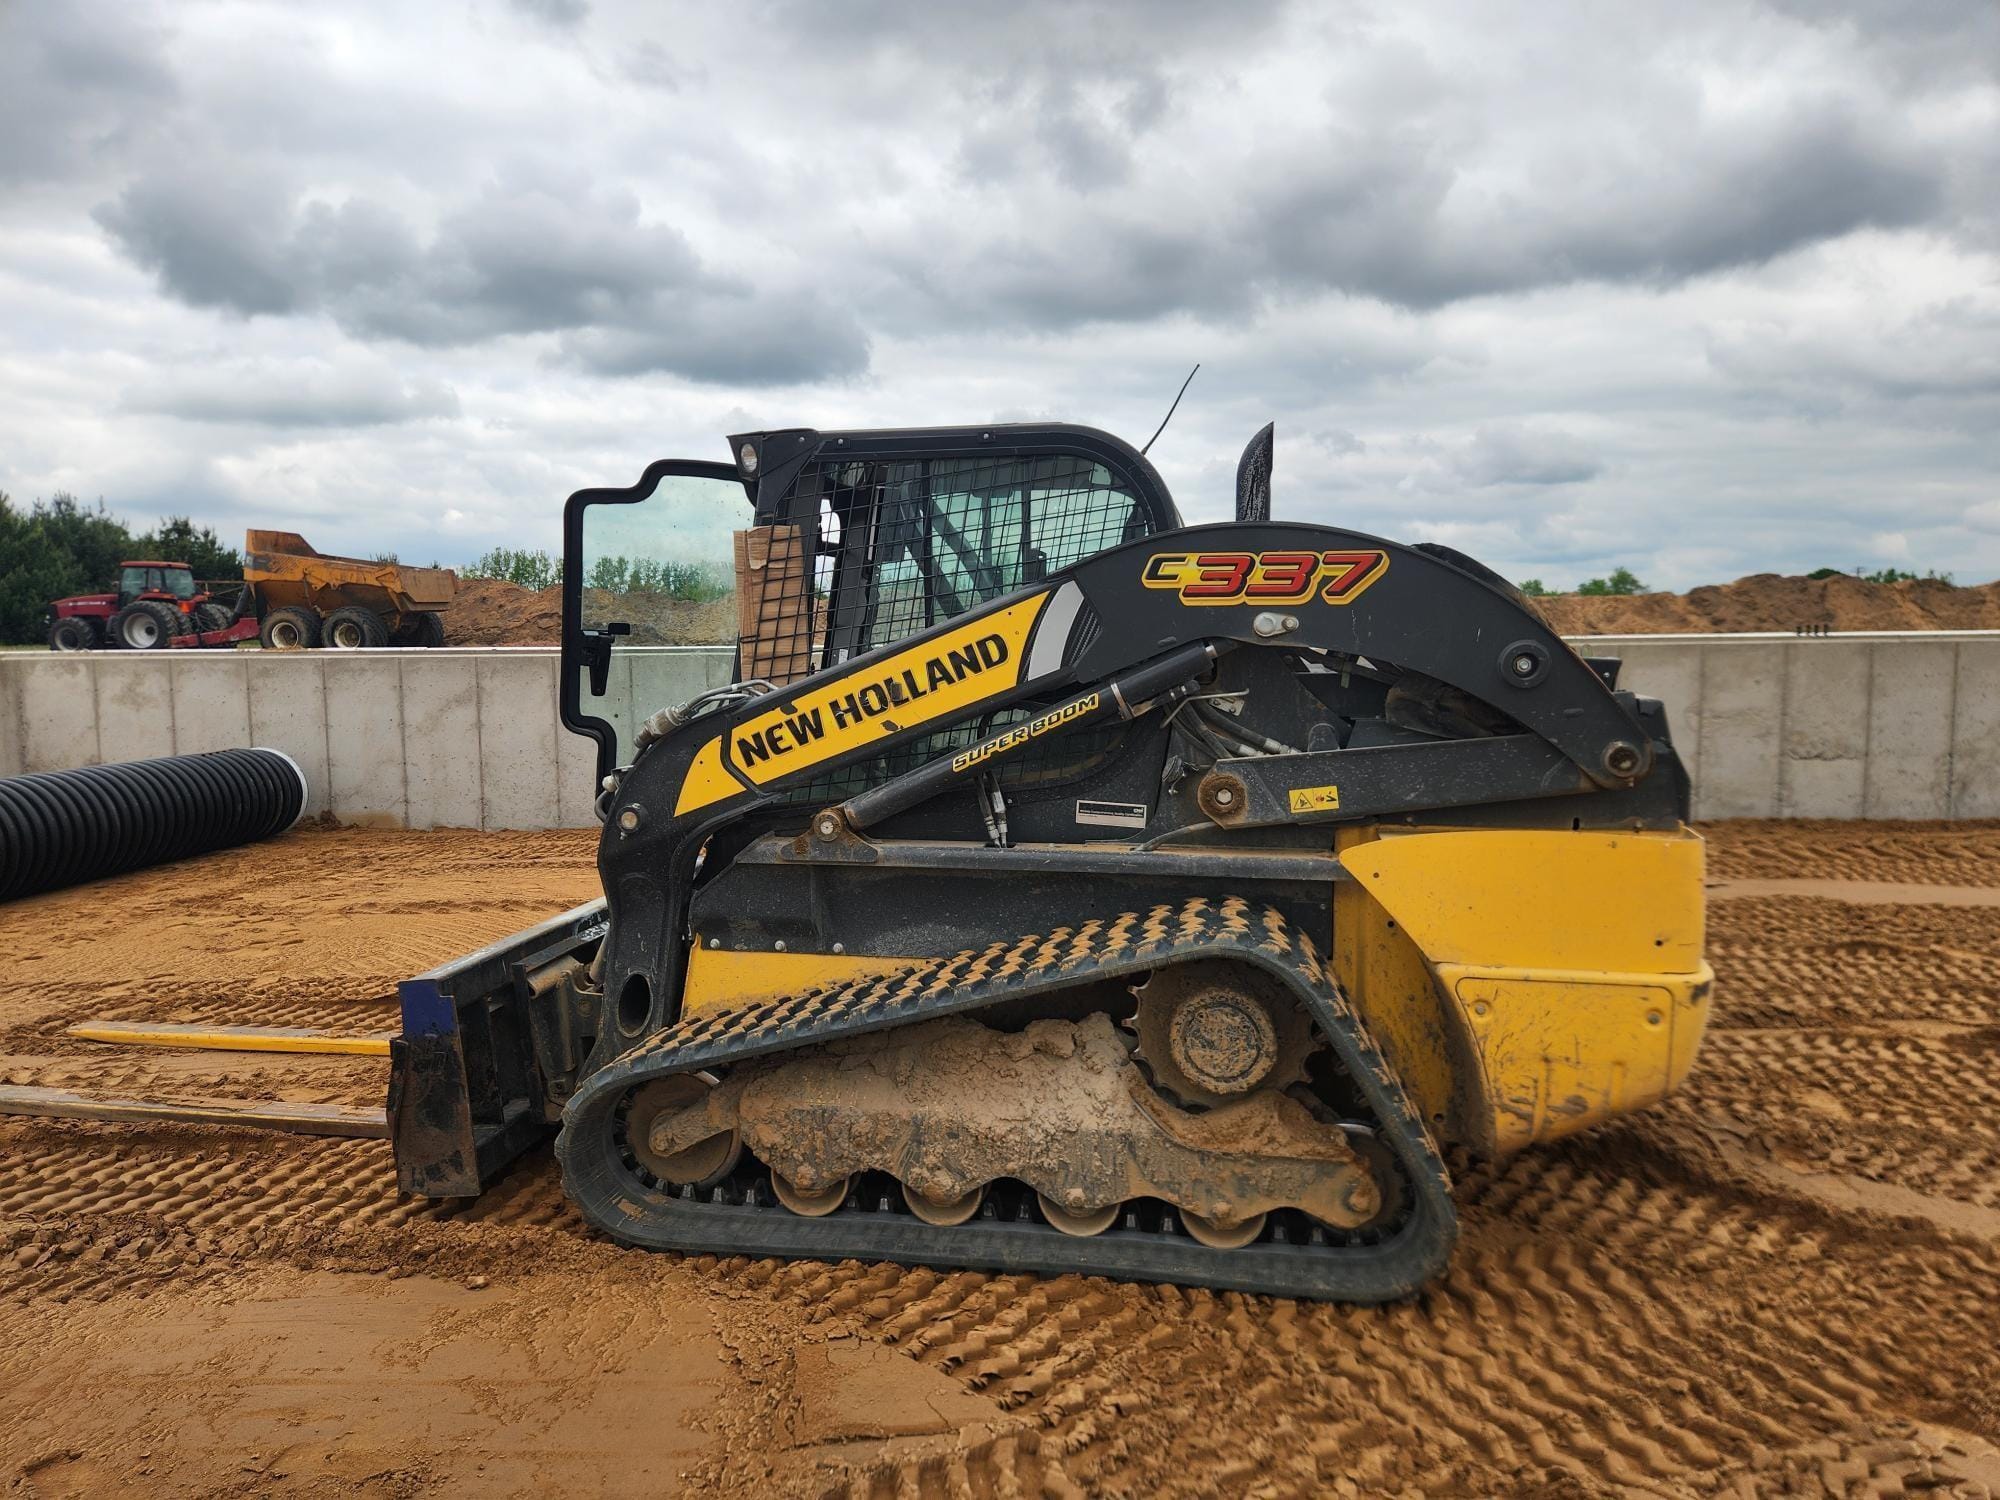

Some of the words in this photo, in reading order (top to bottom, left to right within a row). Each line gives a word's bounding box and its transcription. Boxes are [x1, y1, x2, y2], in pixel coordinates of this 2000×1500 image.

[1143, 551, 1388, 604] C337
[736, 707, 825, 768] NEW
[829, 633, 1009, 730] HOLLAND
[953, 727, 1028, 771] SUPER
[1031, 693, 1099, 736] BOOM
